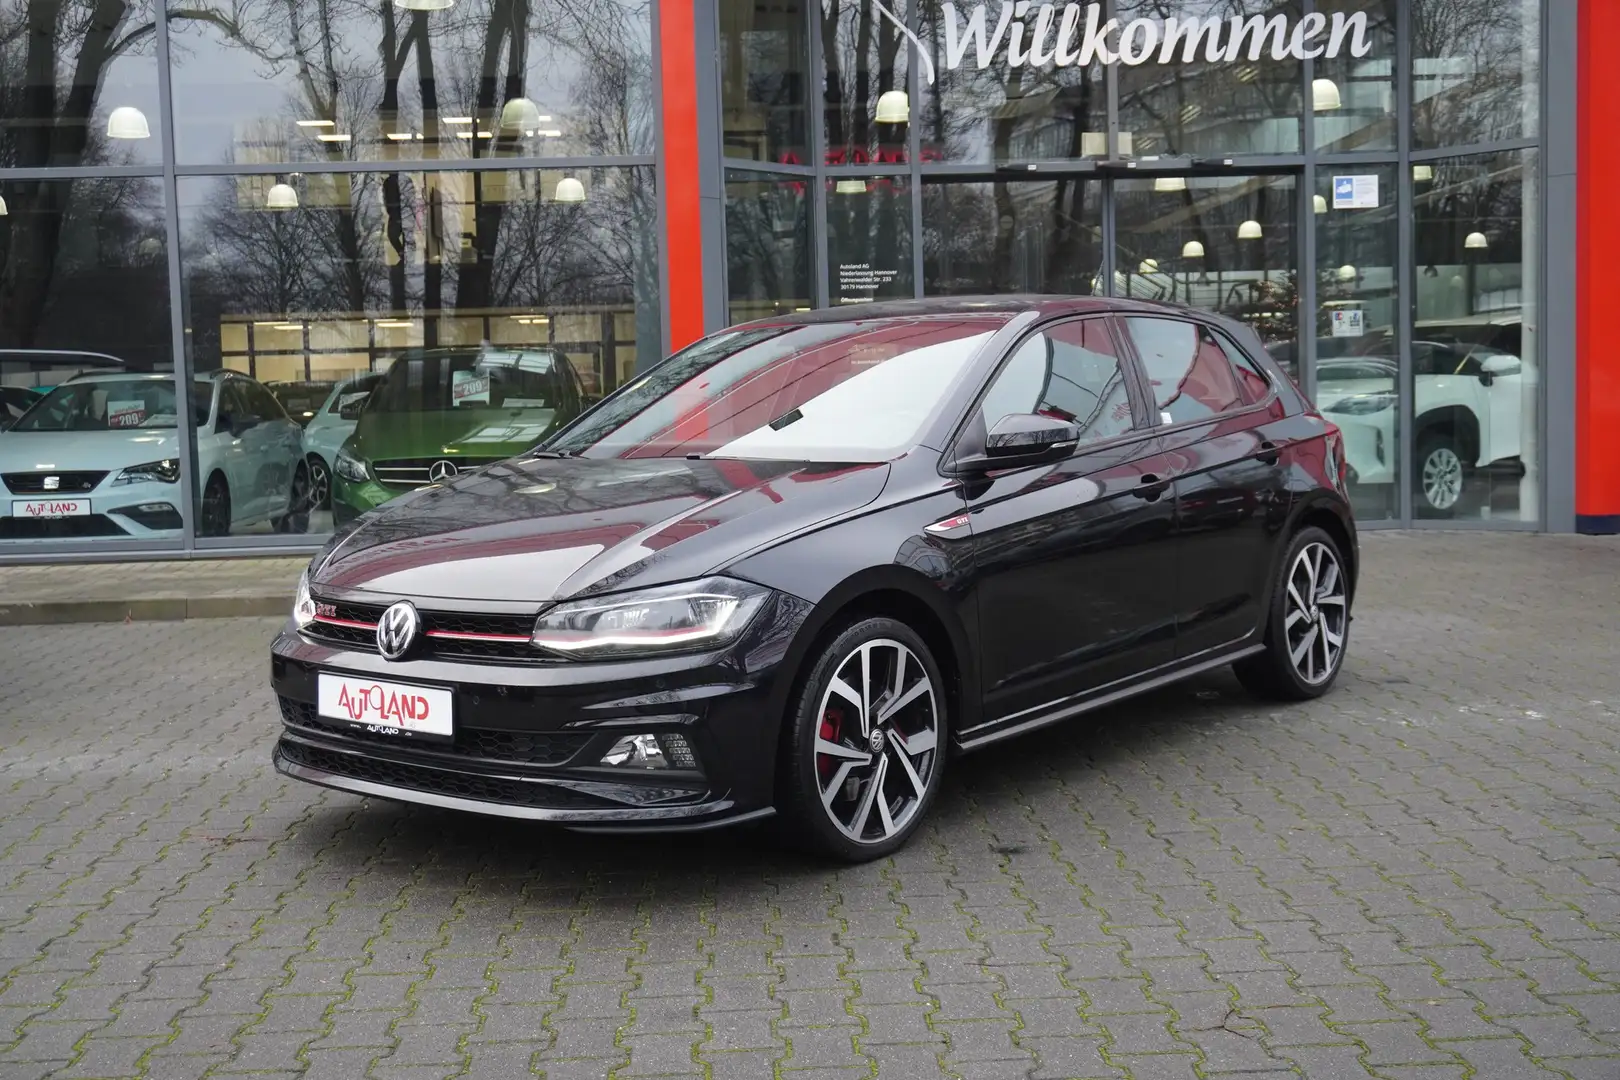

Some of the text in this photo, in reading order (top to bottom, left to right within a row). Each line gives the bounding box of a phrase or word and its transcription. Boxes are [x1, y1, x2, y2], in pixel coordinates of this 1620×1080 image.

[941, 0, 1372, 69] Willkommen
[119, 413, 139, 426] 209
[338, 683, 429, 727] AUTOLAND
